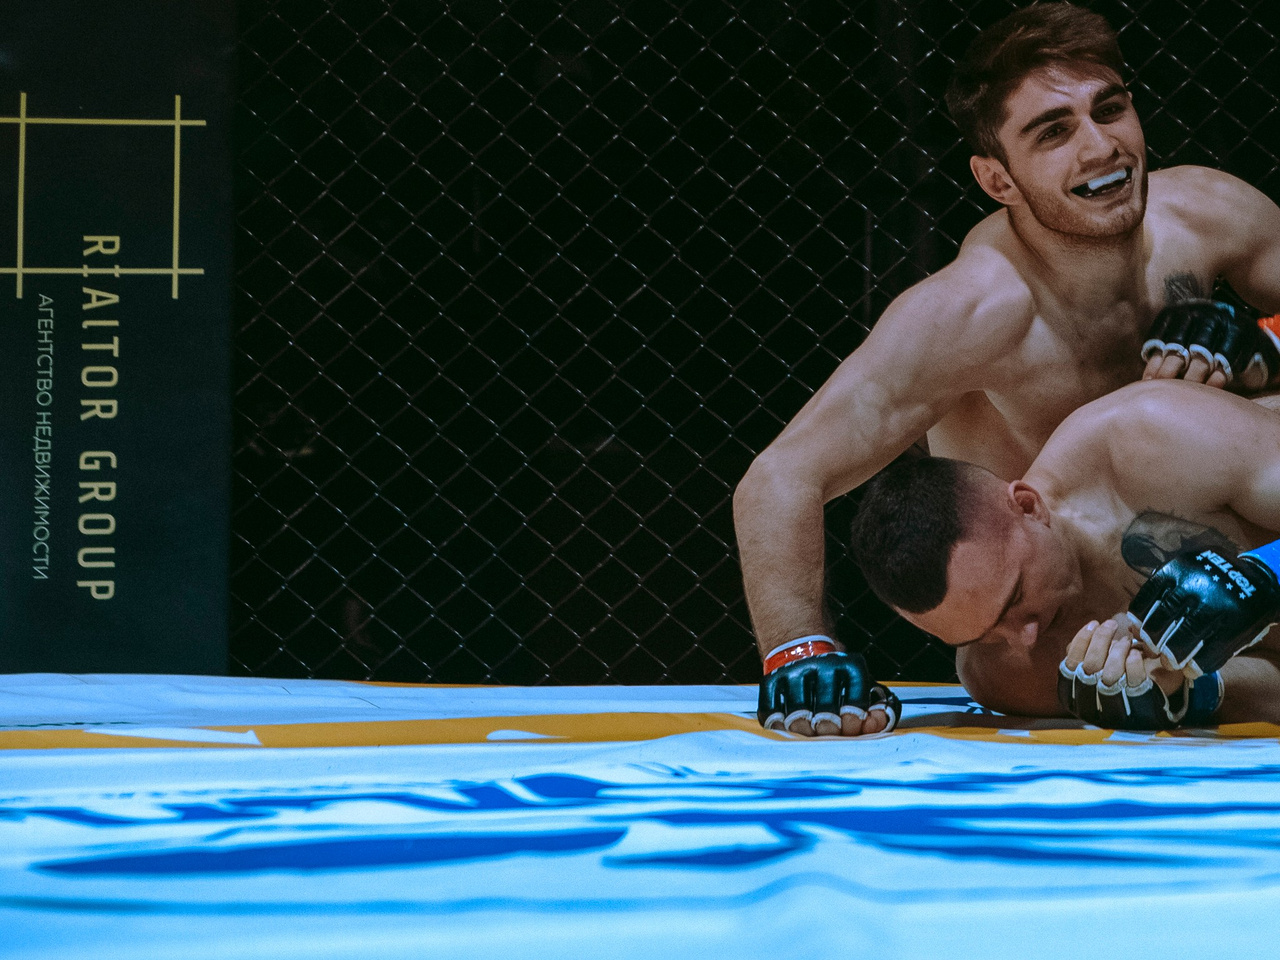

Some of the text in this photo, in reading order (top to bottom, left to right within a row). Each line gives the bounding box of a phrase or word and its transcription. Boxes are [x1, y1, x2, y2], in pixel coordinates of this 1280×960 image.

[31, 292, 54, 581] АГЕНТСТВО НЕДВИЖИМОСТИ
[75, 450, 118, 601] GROUP
[1200, 549, 1257, 598] TOP TEN
